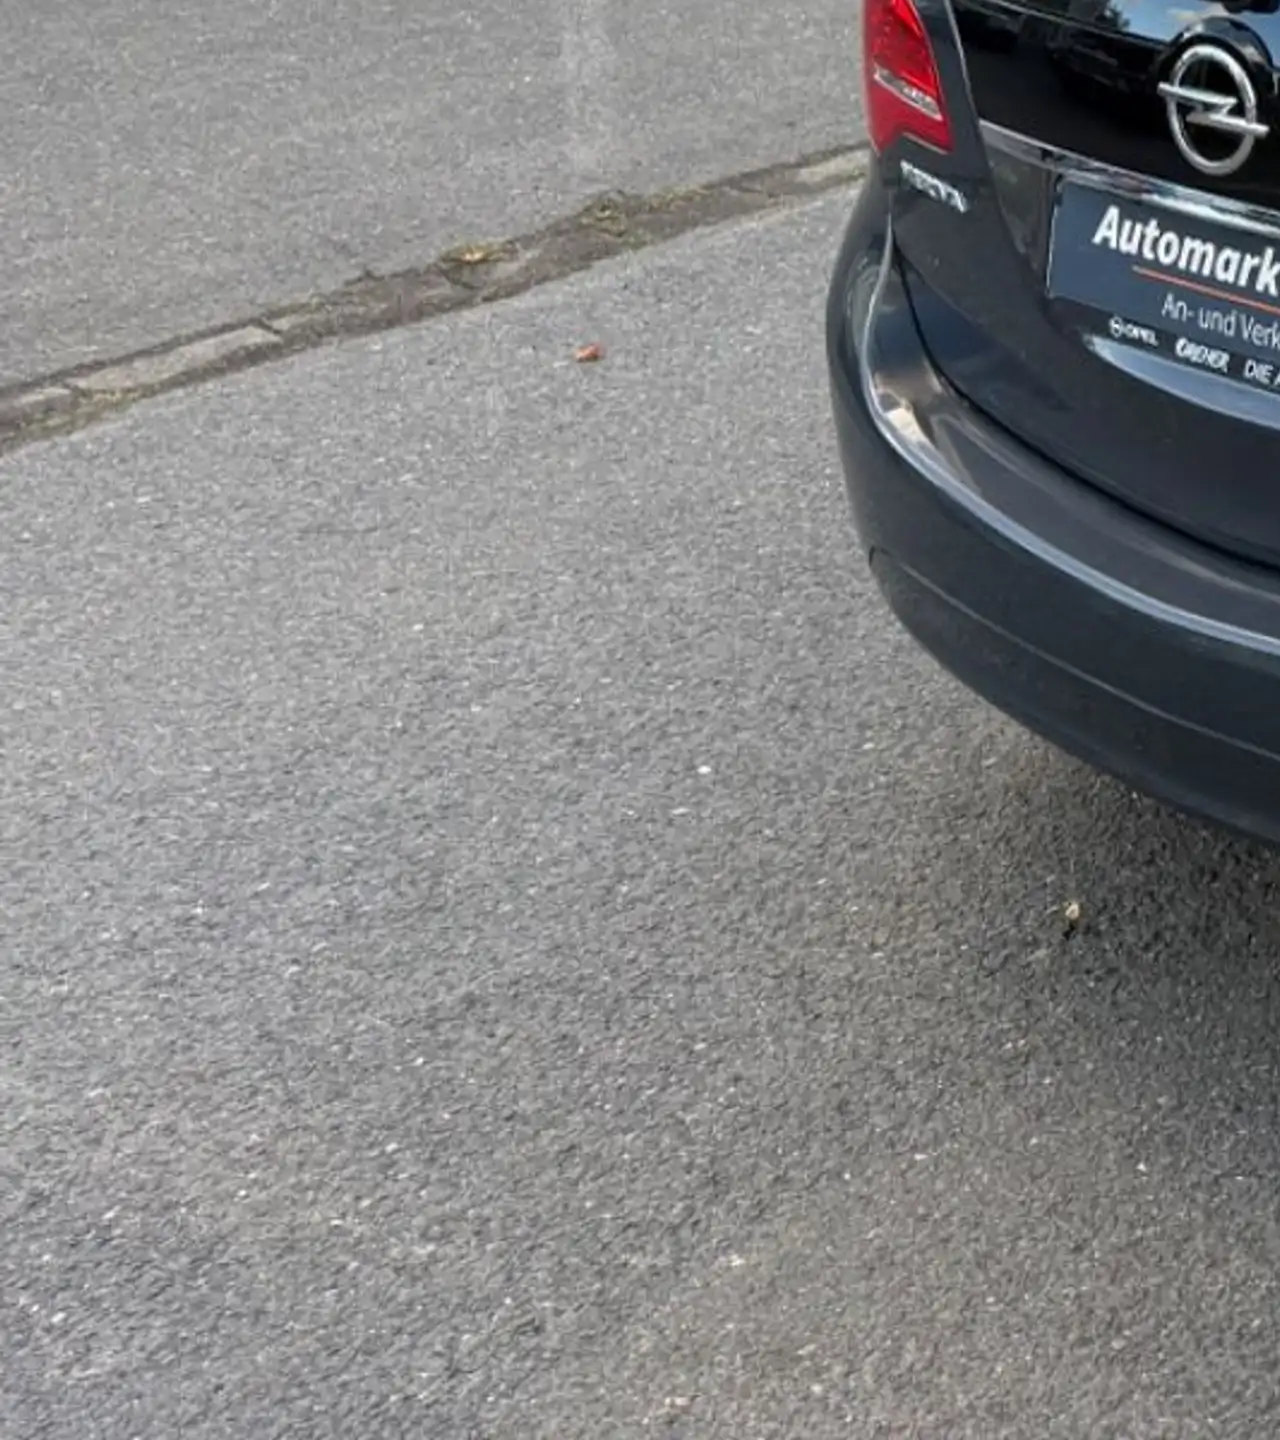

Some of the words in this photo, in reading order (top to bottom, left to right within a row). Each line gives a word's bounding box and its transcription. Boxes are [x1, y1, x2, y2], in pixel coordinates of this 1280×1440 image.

[1162, 292, 1194, 322] An-
[1197, 307, 1236, 337] und
[1244, 359, 1272, 385] DIE
